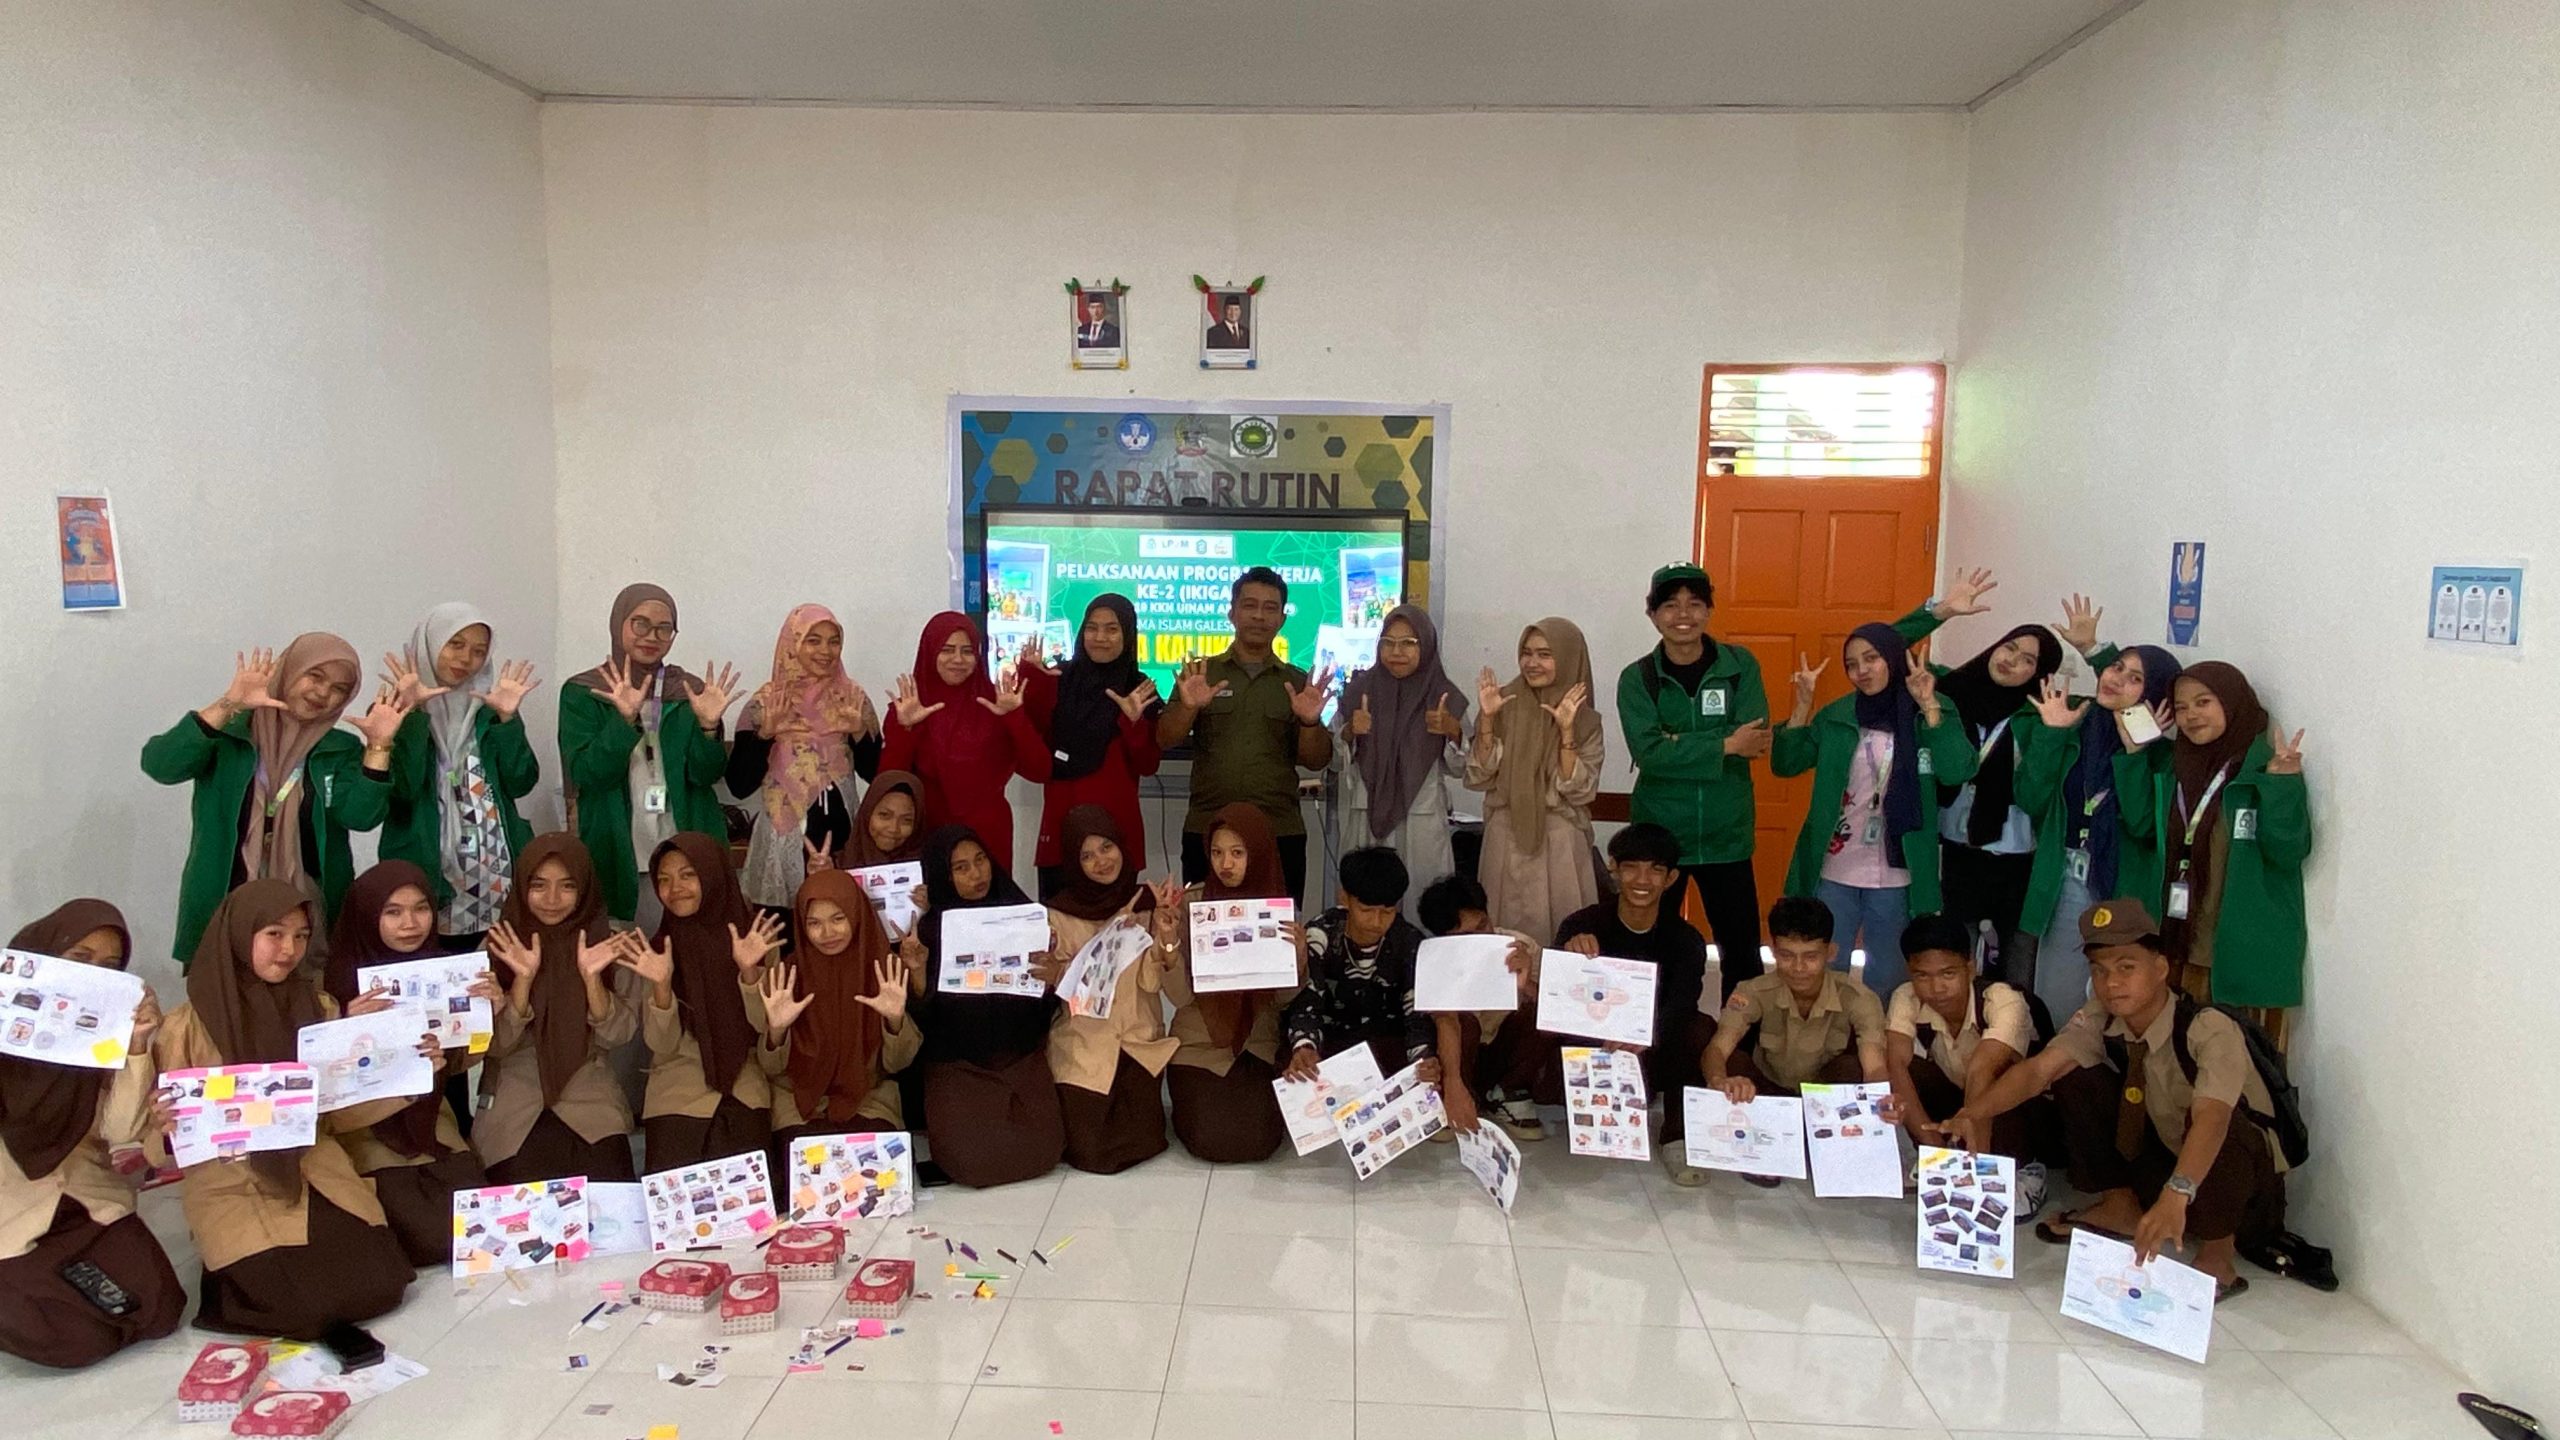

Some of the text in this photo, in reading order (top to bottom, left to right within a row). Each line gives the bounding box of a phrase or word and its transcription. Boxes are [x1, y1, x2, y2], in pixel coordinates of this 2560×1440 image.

[1054, 469, 1340, 508] RAPAT RUTIN
[1056, 563, 1180, 580] PELAKSANAAN
[1183, 565, 1250, 581] PROGR
[1137, 584, 1175, 600] KE-2
[1158, 619, 1193, 632] ISLAM
